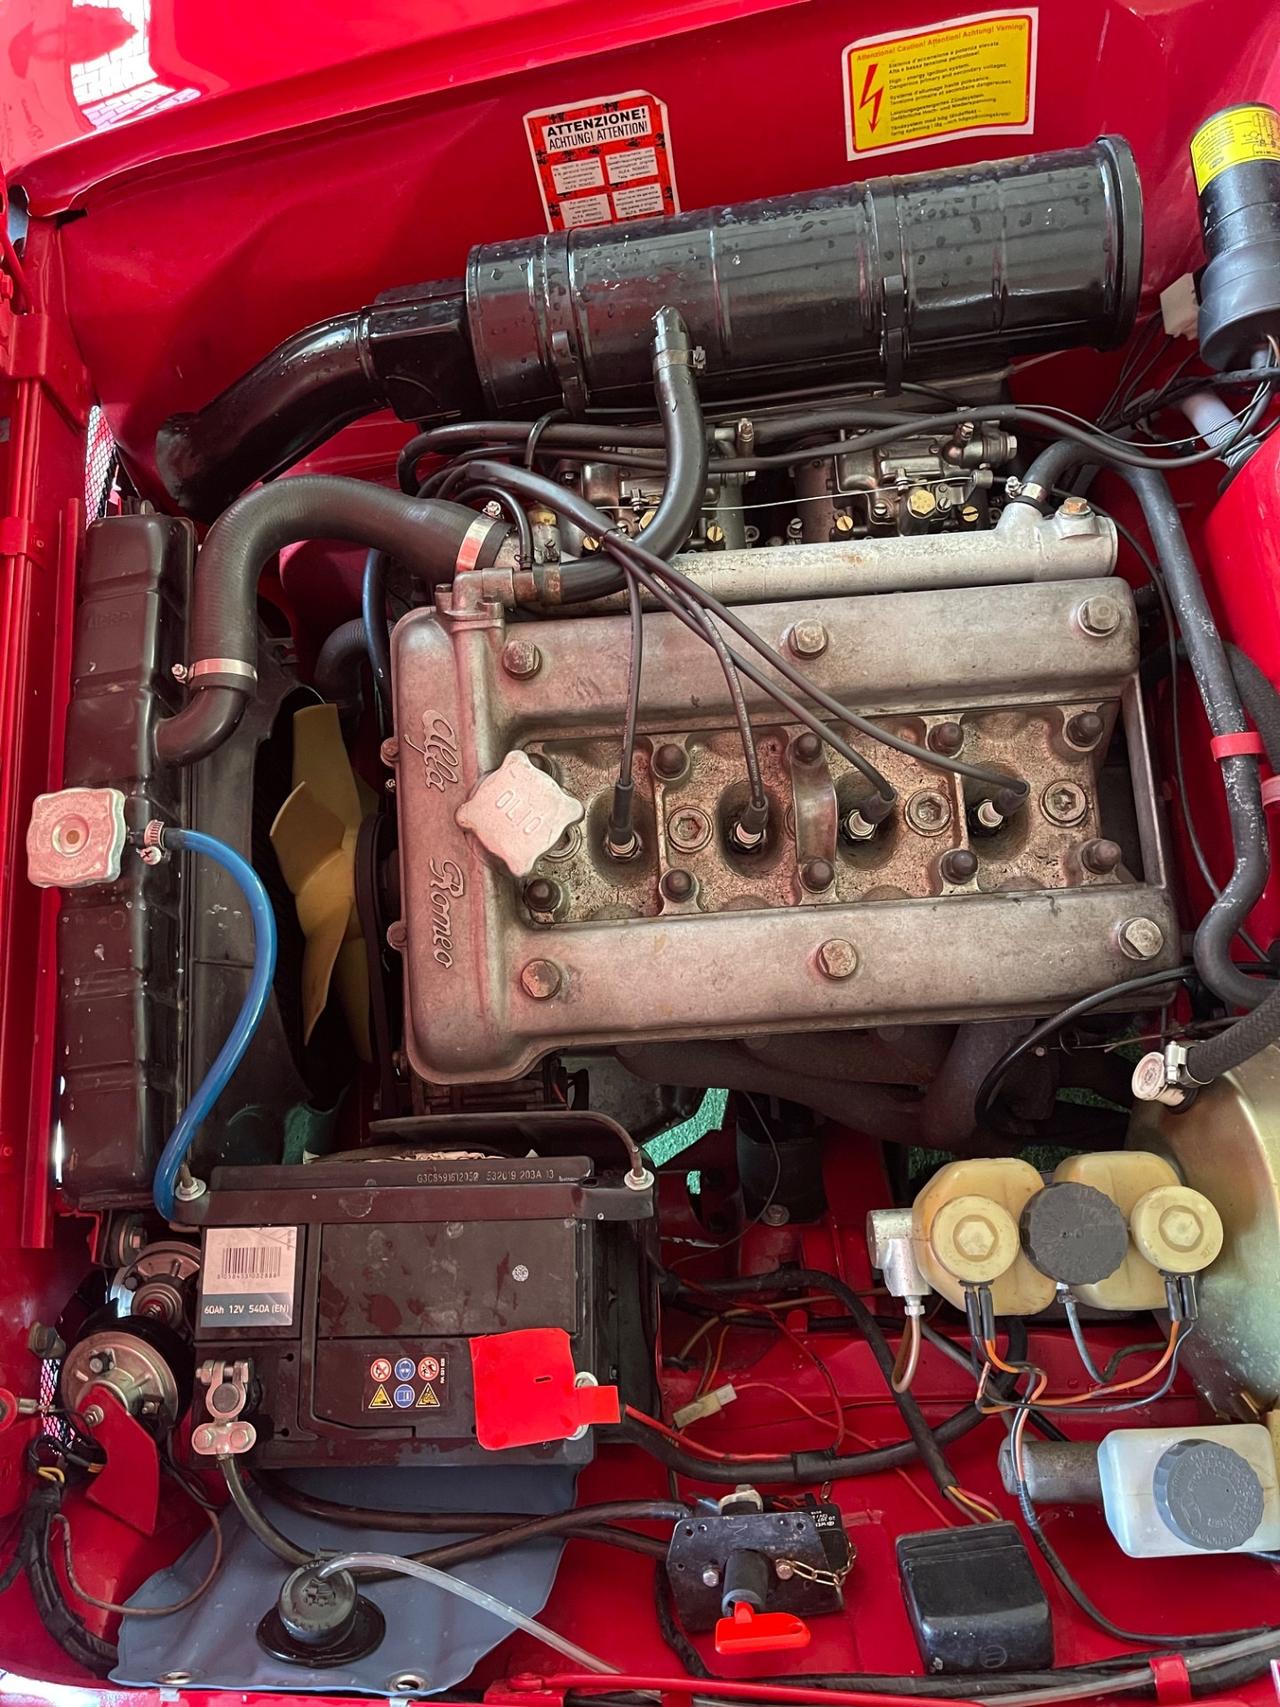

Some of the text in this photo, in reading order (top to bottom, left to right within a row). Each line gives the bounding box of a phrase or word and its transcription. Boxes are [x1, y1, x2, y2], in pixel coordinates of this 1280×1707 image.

[857, 46, 896, 62] Attenzione!
[897, 40, 926, 52] Caution!
[928, 33, 960, 46] Attention!
[963, 26, 994, 38] Achtung!
[547, 108, 646, 137] ATTENZIONE!
[550, 120, 648, 151] ACHTUNG! ATTENTION!
[404, 710, 458, 792] Alfa
[495, 790, 542, 836] OLIO
[428, 857, 464, 970] Romeo
[204, 1304, 289, 1314] 60Ah 12V 540A (EN)
